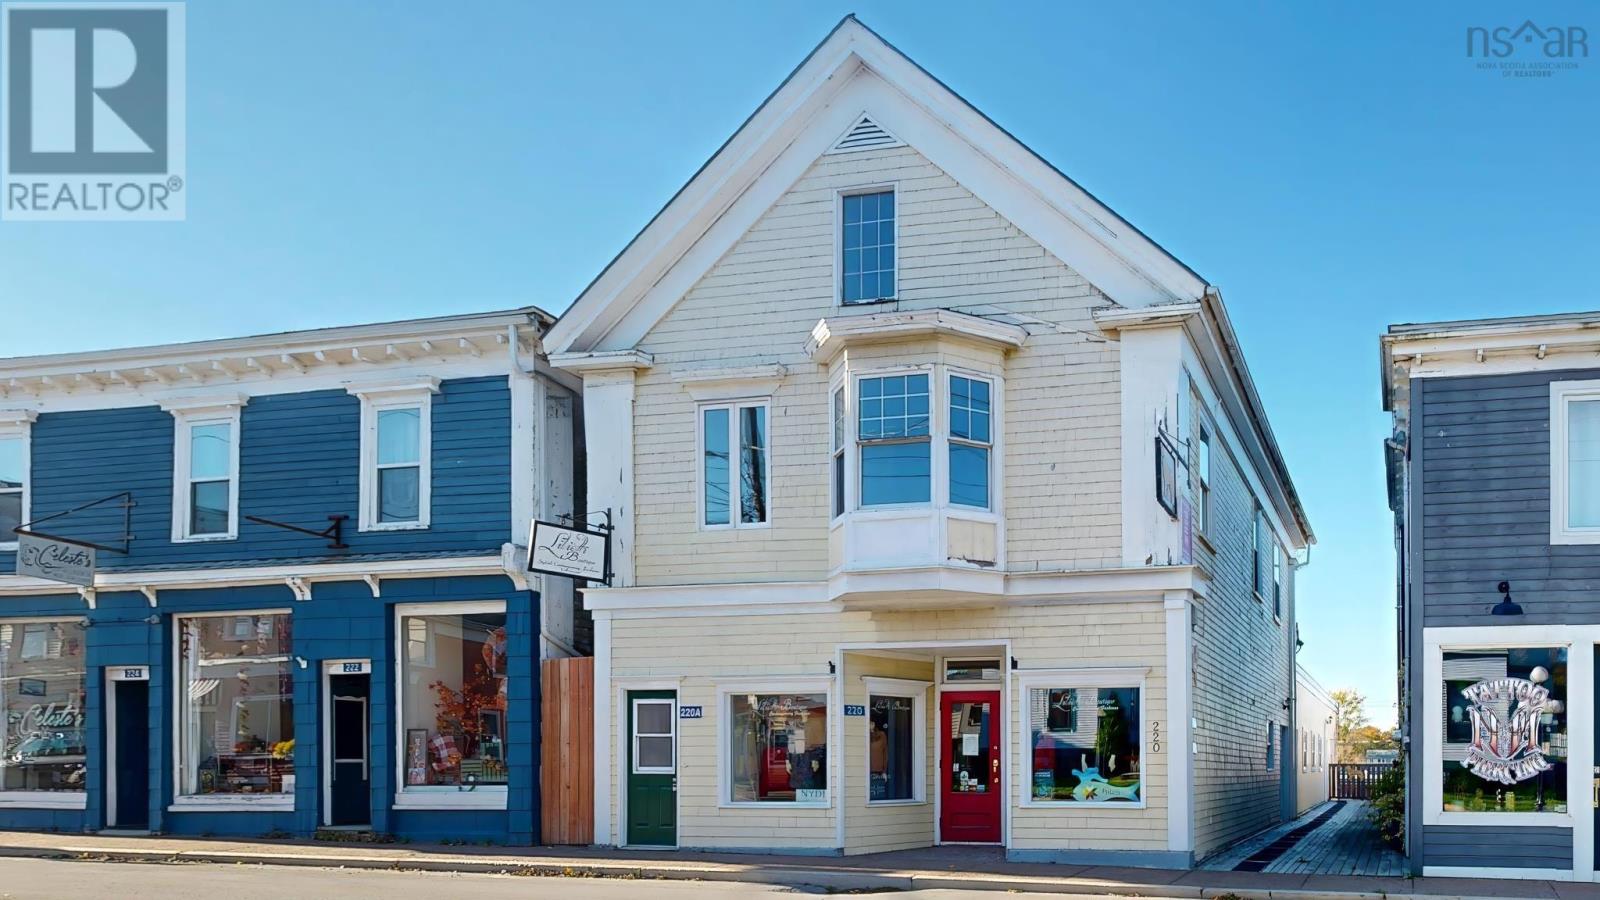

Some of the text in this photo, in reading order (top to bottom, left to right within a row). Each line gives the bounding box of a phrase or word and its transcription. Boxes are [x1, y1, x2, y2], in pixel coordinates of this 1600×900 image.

[345, 663, 360, 672] 222
[1461, 679, 1550, 706] TATTOO
[680, 707, 701, 718] 220A
[847, 706, 863, 715] 220
[1152, 721, 1160, 753] 220
